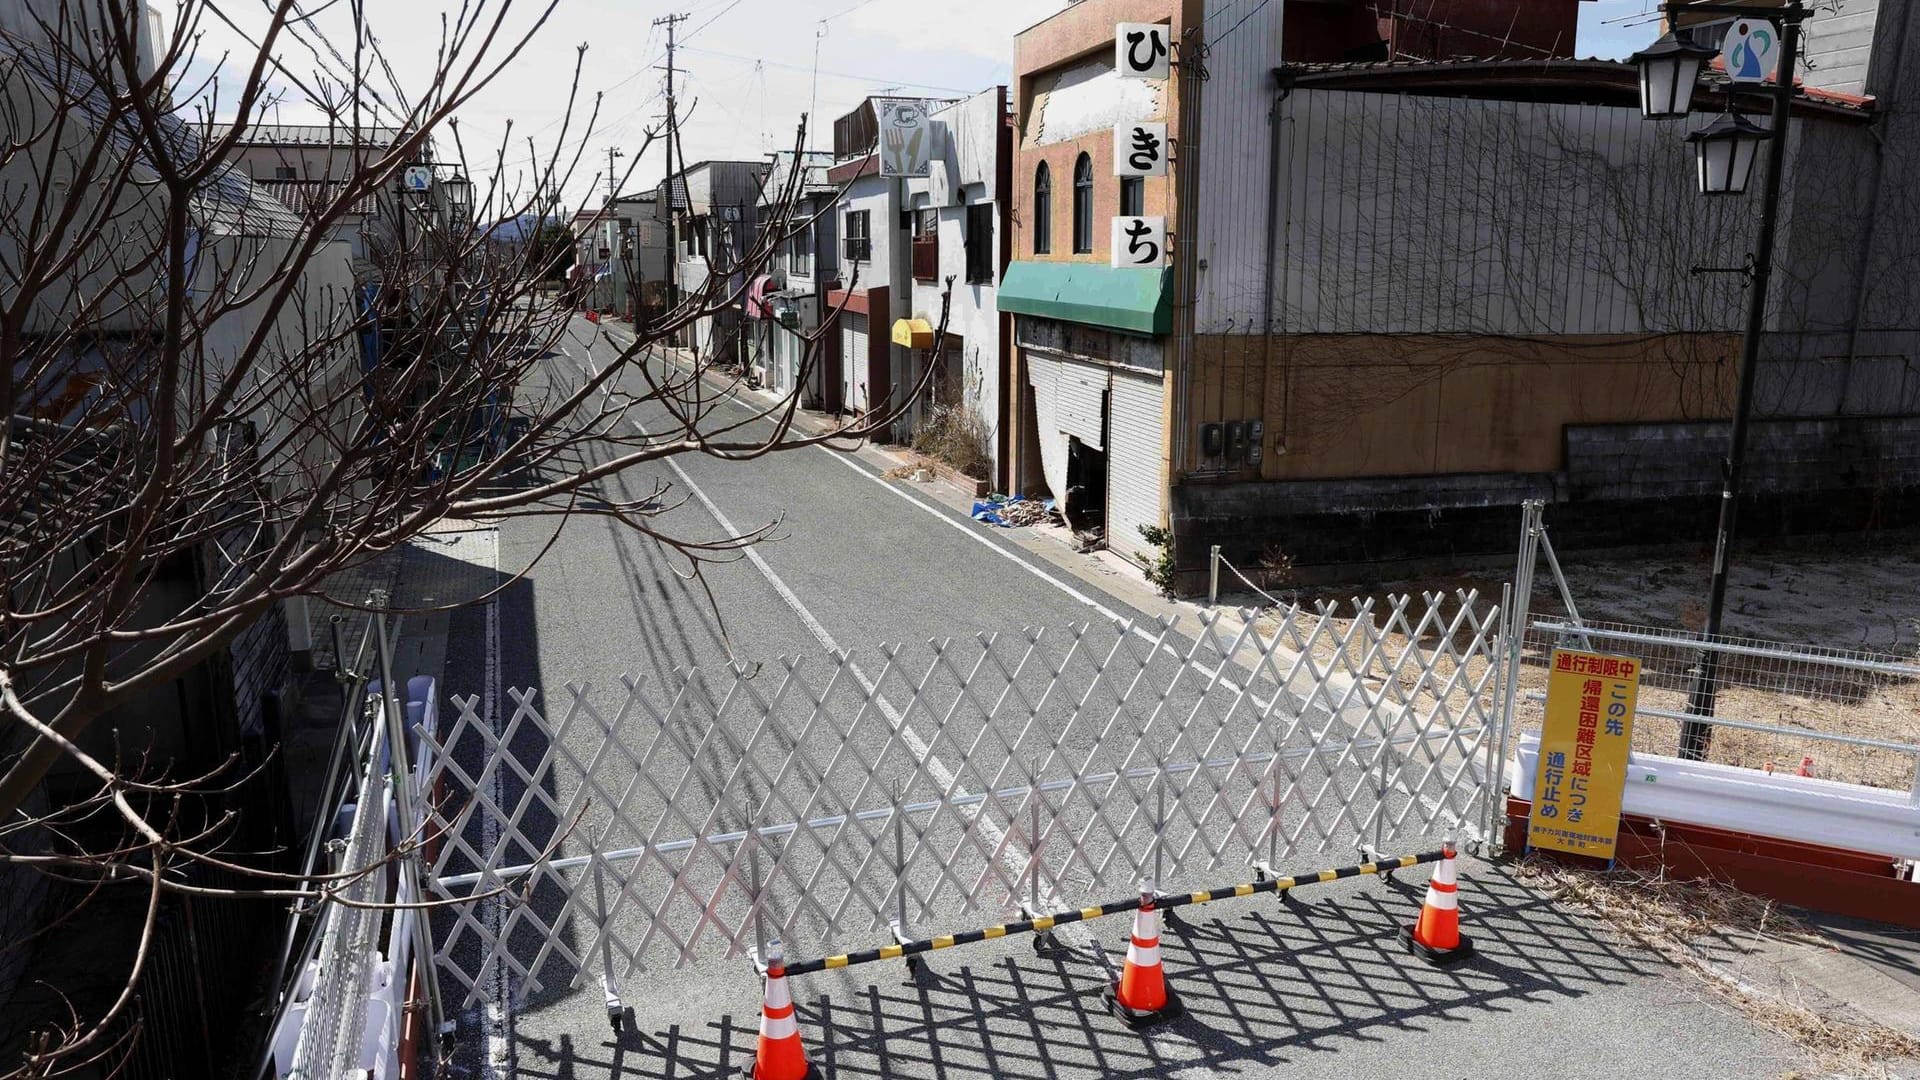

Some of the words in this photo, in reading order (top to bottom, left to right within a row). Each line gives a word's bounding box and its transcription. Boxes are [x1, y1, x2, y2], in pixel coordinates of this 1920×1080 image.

[1556, 653, 1635, 678] 通行制限中
[1604, 684, 1627, 737] この先
[1566, 679, 1603, 823] 帰還困難区域につき
[1540, 751, 1566, 819] 通行止め
